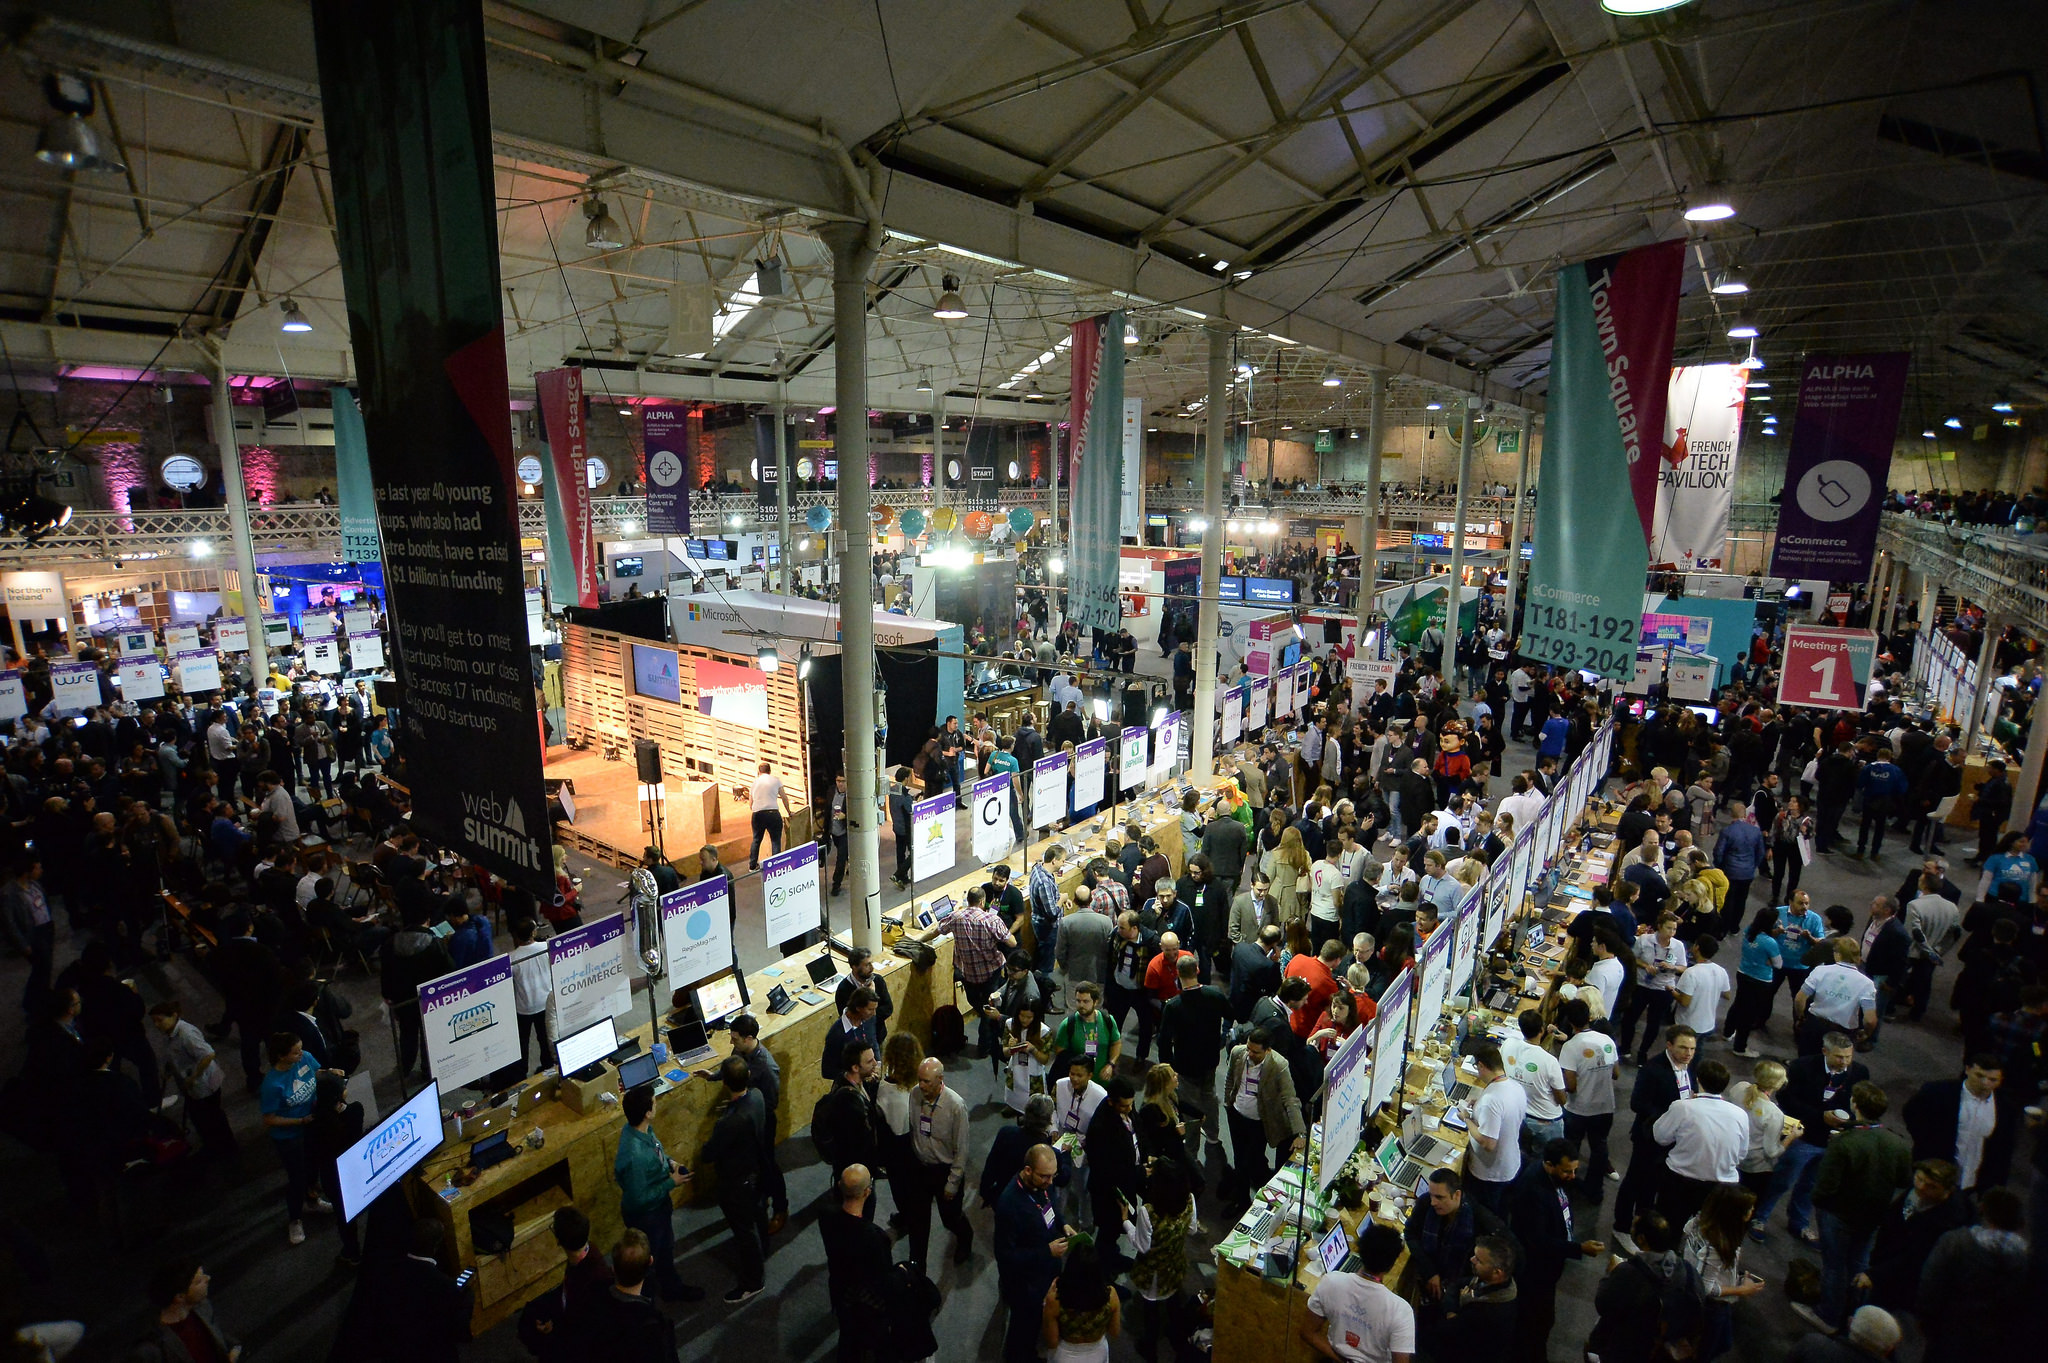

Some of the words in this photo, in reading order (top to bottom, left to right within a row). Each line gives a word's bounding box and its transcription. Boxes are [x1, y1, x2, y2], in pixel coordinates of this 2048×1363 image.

[1589, 267, 1619, 356] Town
[1607, 355, 1641, 465] Square
[1807, 364, 1875, 380] ALPHA
[567, 376, 581, 438] Stage
[646, 411, 675, 420] ALPHA
[1072, 409, 1092, 465] Town
[1690, 440, 1732, 452] FRENCH
[1689, 453, 1730, 471] TECH
[1658, 471, 1728, 489] PAVILION
[388, 482, 409, 501] last
[411, 485, 431, 505] year
[432, 481, 445, 501] 40
[447, 485, 493, 505] young
[410, 510, 431, 530] who
[433, 512, 451, 530] also
[453, 511, 482, 532] had
[345, 535, 377, 546] T125
[407, 538, 443, 562] booths,
[444, 541, 475, 560] have
[1779, 535, 1848, 547] eCommerce
[347, 549, 379, 560] T139
[392, 563, 406, 584] $1
[408, 565, 438, 586] billion
[439, 568, 449, 588] in
[451, 569, 504, 595] funding
[7, 587, 52, 595] Northern
[1532, 583, 1600, 607] eCommerce
[702, 607, 741, 623] Microsoft
[1531, 602, 1634, 644] T181-192
[447, 629, 465, 648] get
[468, 629, 483, 647] to
[874, 631, 904, 646] rosoft
[1792, 639, 1837, 653] Meeting
[1839, 643, 1871, 654] Point
[443, 651, 468, 674] from
[472, 661, 496, 676] our
[1526, 632, 1629, 676] T193-204
[1809, 657, 1840, 701] 1
[420, 677, 452, 697] across
[454, 681, 467, 700] 17
[471, 683, 523, 713] industries
[700, 682, 745, 697] Breakthrough
[745, 683, 765, 693] Stage
[448, 707, 497, 733] startups
[1036, 766, 1053, 778] ALPHA
[974, 788, 994, 801] ALPHA
[461, 790, 503, 824] web
[914, 810, 937, 824] ALPHA
[463, 817, 542, 871] summit
[801, 854, 815, 864] T-177
[765, 864, 793, 883] ALPHA
[707, 889, 724, 900] T-178
[788, 879, 816, 897] SIGMA
[665, 900, 699, 920] ALPHA
[563, 932, 588, 944] eCommerce
[602, 928, 620, 941] T-179
[553, 942, 591, 965] ALPHA
[560, 952, 622, 985] intelligent
[437, 977, 467, 991] eCommerce
[484, 972, 506, 986] T-180
[560, 963, 623, 997] COMMERCE
[426, 987, 471, 1014] ALPHA
[285, 1077, 316, 1104] STARTUP
[1329, 1067, 1351, 1097] ALPHA
